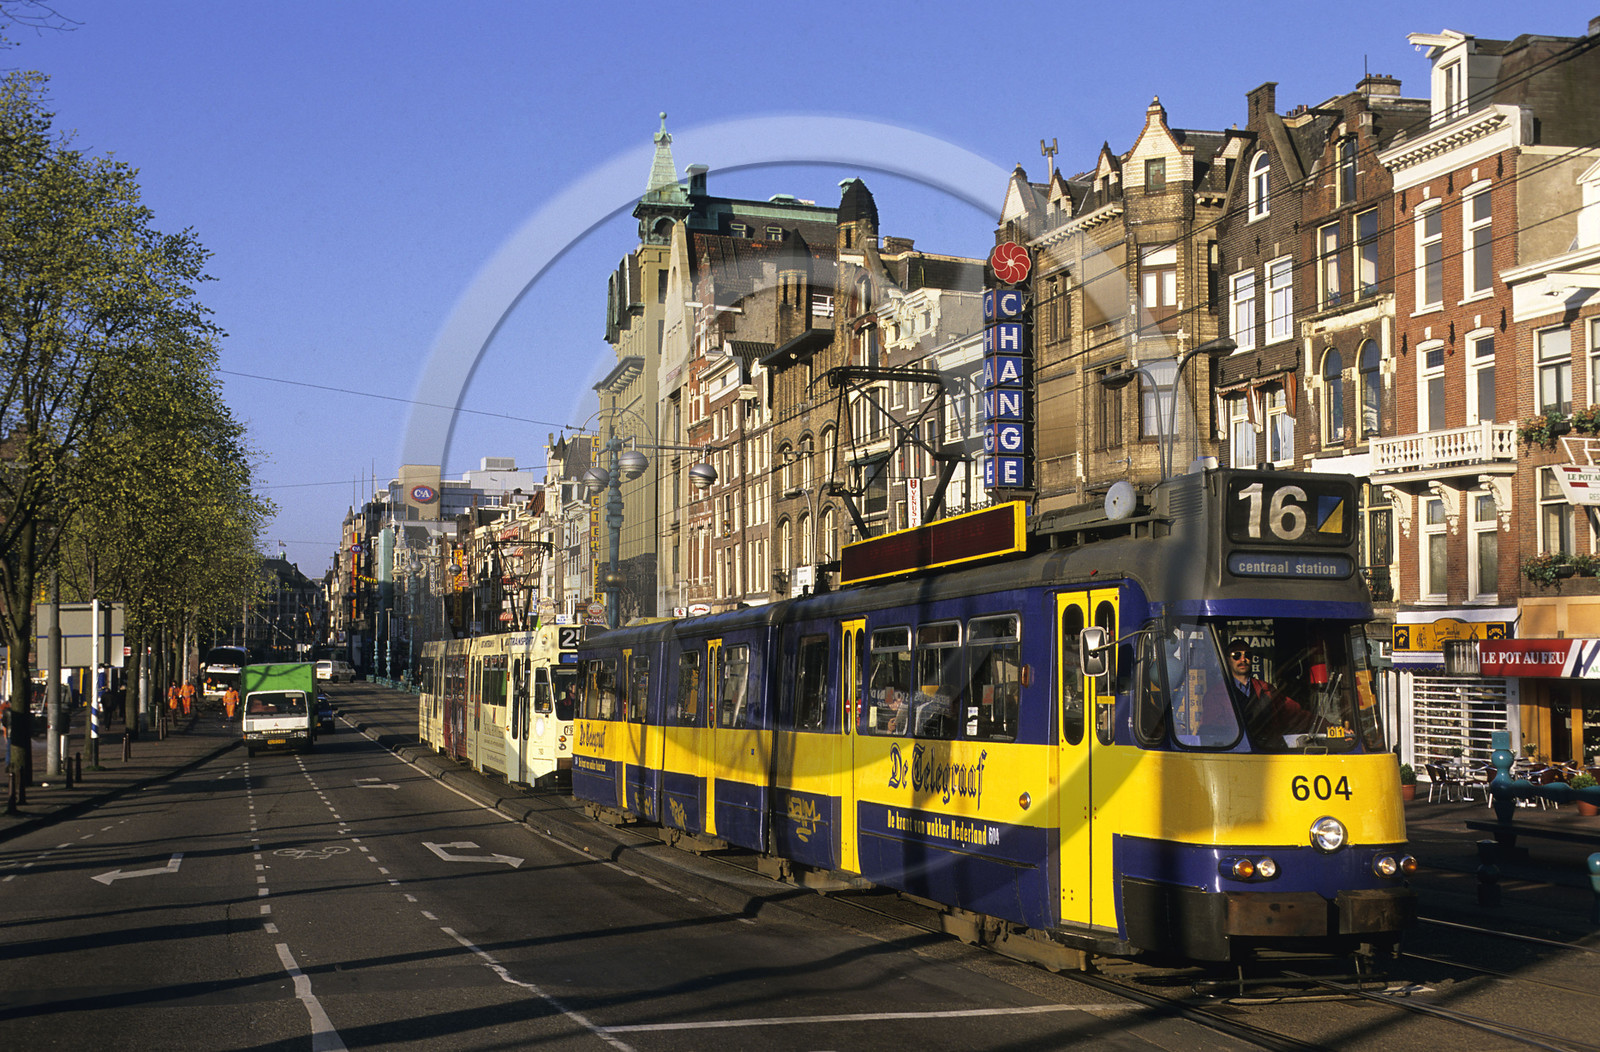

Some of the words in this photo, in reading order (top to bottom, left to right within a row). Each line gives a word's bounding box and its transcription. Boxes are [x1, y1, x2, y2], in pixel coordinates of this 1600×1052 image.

[983, 295, 995, 485] CHANGE
[1000, 293, 1021, 484] CHANGE
[414, 489, 431, 498] C&A
[1238, 482, 1308, 541] 16
[1239, 561, 1289, 574] centraal
[1296, 562, 1337, 575] station
[1482, 652, 1492, 664] LE
[1499, 652, 1521, 664] POT
[1523, 652, 1540, 664] AU
[1541, 652, 1565, 664] FEU
[888, 742, 908, 790] De
[912, 743, 987, 811] Telegraaf
[1291, 775, 1353, 801] 604
[888, 809, 895, 829] De
[896, 811, 912, 831] krant
[914, 820, 925, 834] van
[927, 817, 949, 839] wakker
[951, 820, 987, 846] Nederland
